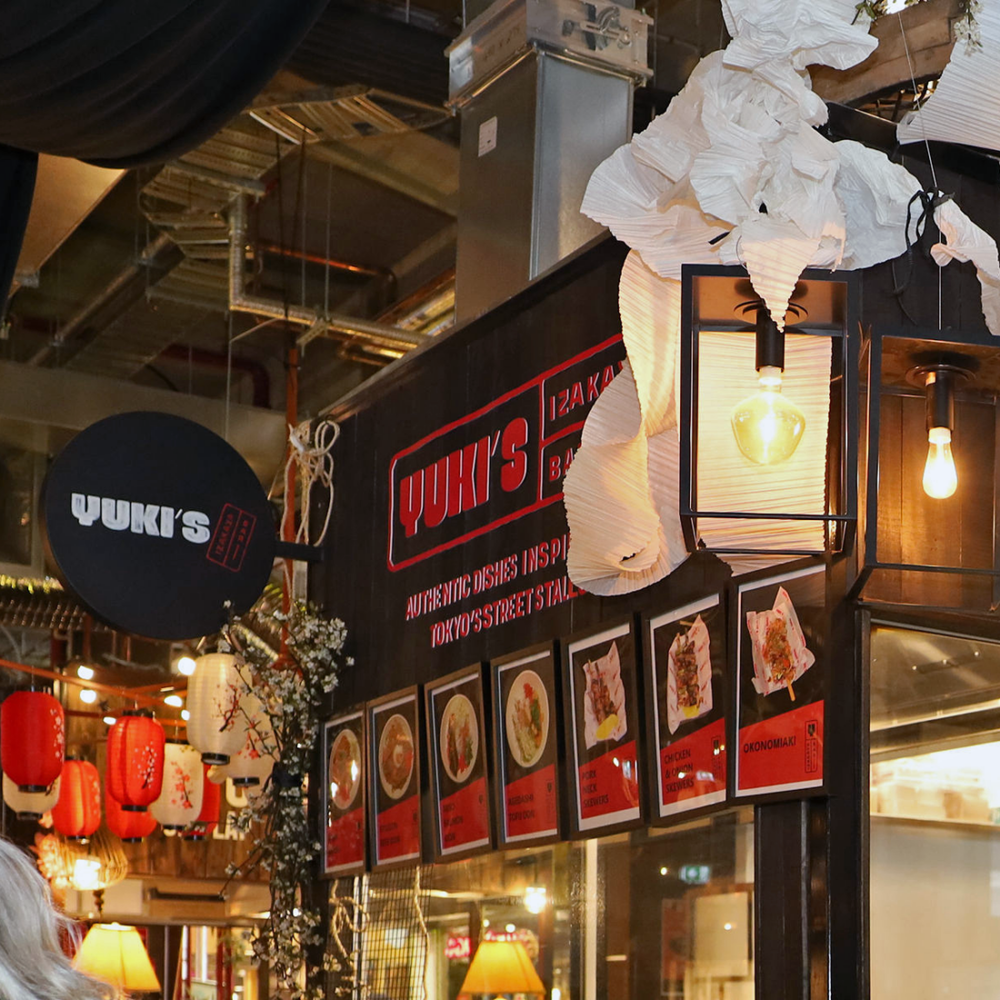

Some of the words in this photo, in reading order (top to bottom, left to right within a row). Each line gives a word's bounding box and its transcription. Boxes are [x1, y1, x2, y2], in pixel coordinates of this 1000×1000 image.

[549, 360, 624, 421] IZAKA
[399, 417, 528, 538] YUKI'S
[548, 442, 582, 482] BA
[71, 492, 210, 544] YUKI'S
[405, 573, 471, 621] AUTHENTIC
[472, 553, 518, 595] DISHES
[521, 532, 570, 576] INSPI
[429, 607, 483, 649] TOKYO'S
[482, 587, 535, 629] STREET
[663, 749, 691, 765] CHICKEN
[743, 736, 797, 754] OKONOMIAKI
[583, 794, 609, 809] SKEWERS
[664, 778, 695, 794] SKEWERS
